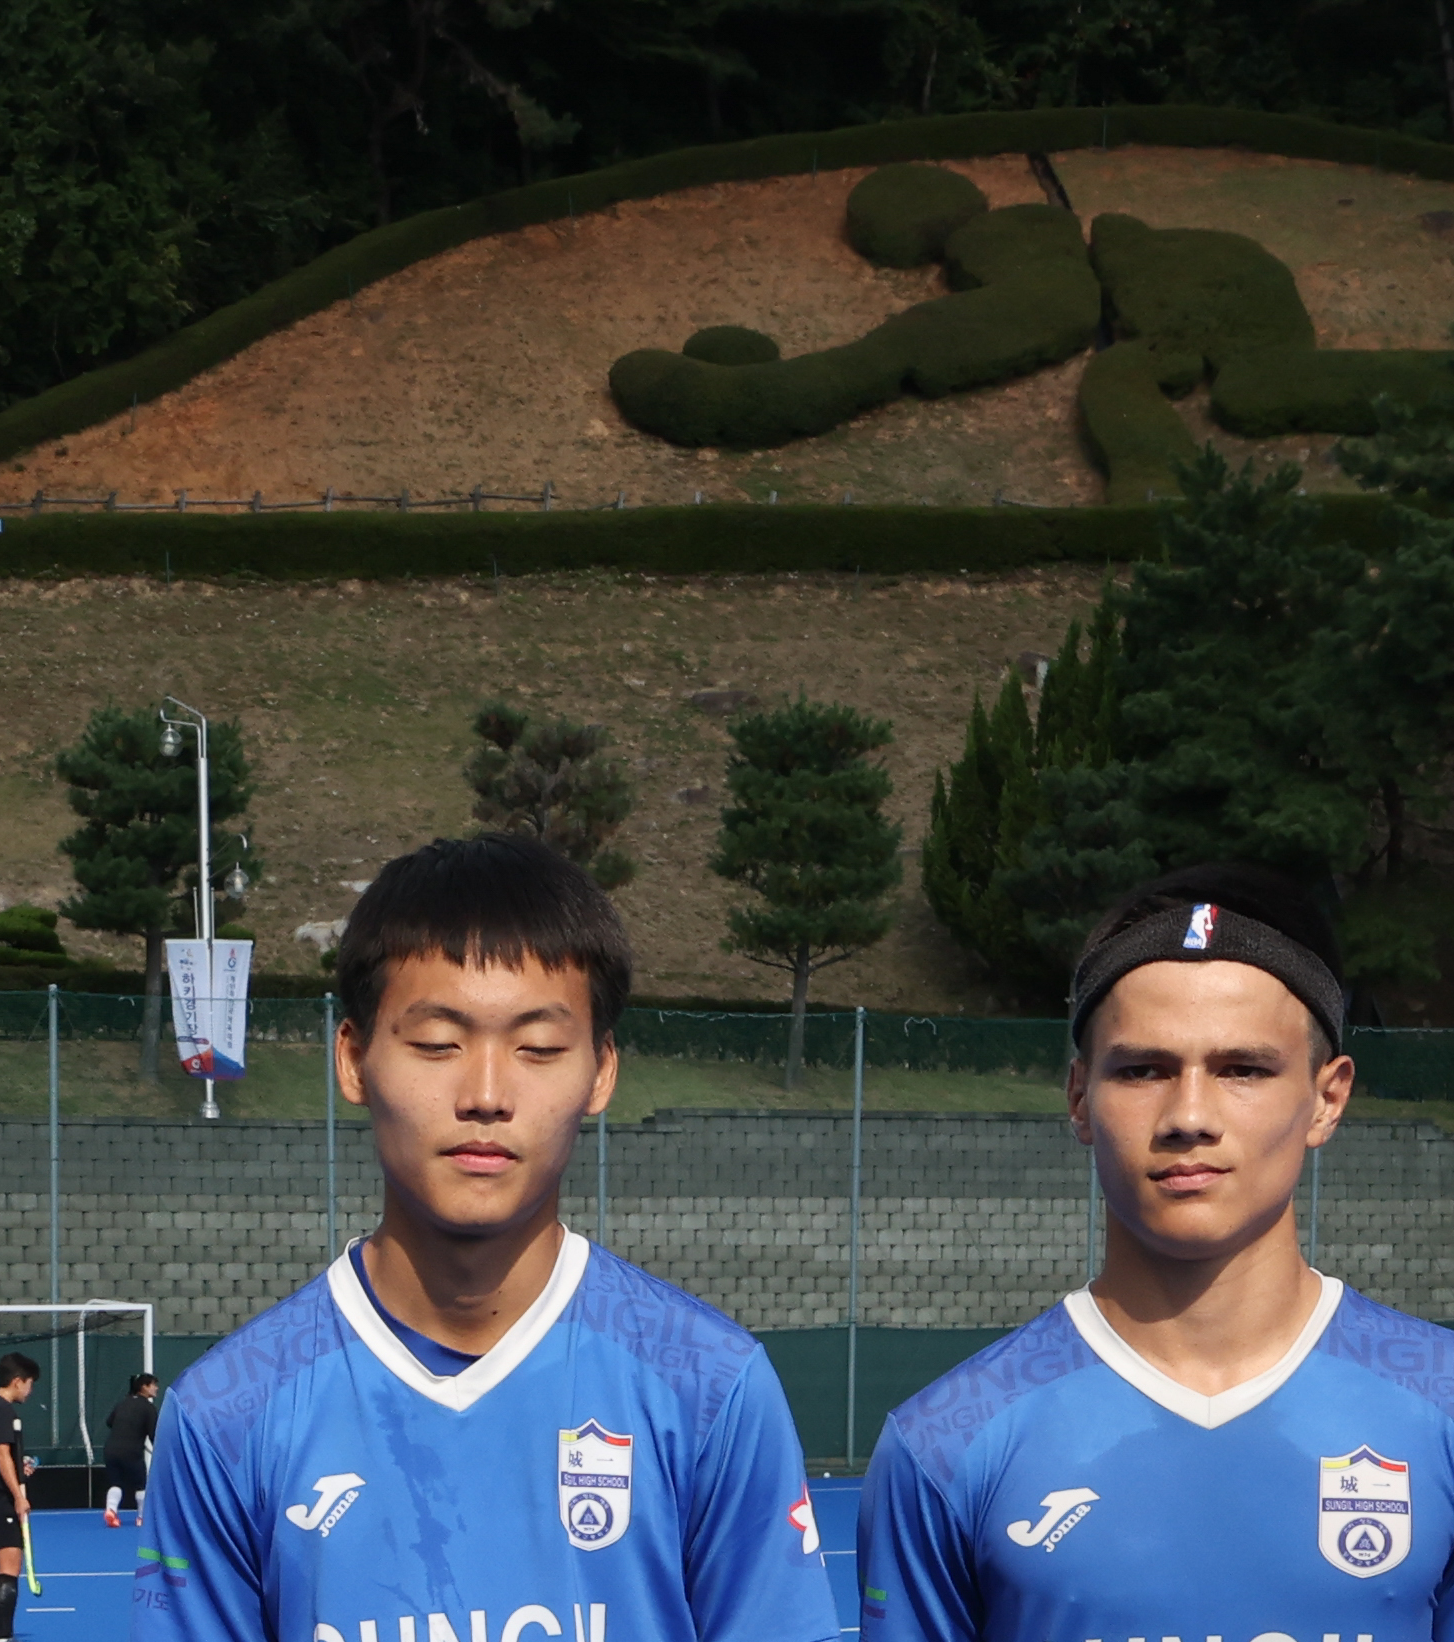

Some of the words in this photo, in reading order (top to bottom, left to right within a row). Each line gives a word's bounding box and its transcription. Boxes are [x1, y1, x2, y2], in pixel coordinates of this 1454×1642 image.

[1325, 1500, 1354, 1511] SUNGIL
[1355, 1500, 1375, 1512] HIGH
[1375, 1501, 1407, 1514] SCHOOL
